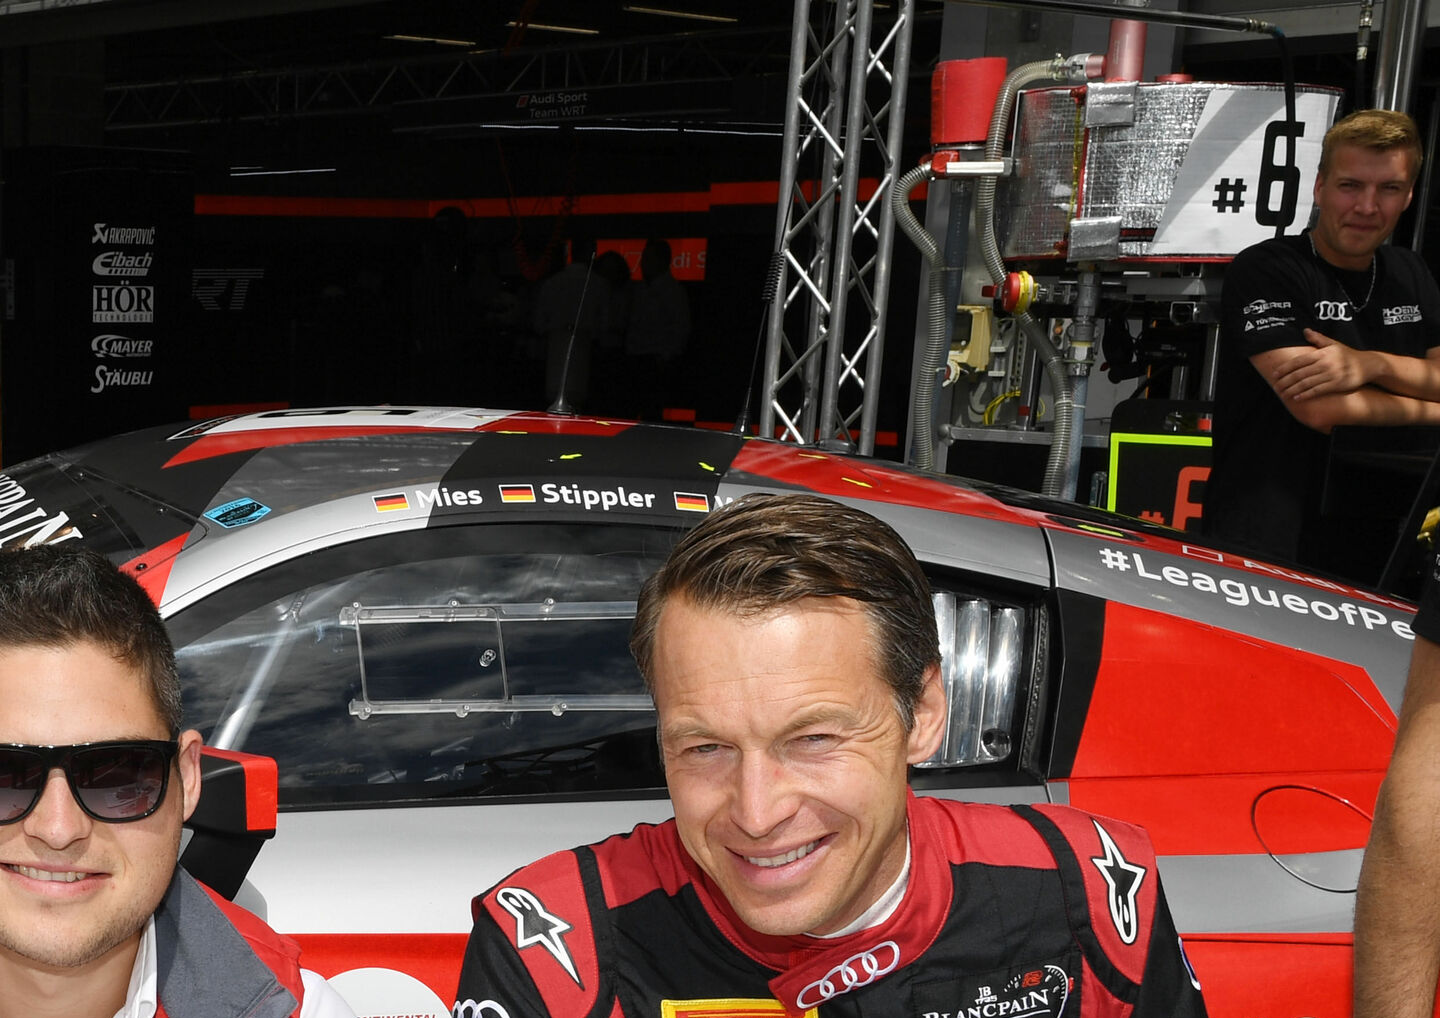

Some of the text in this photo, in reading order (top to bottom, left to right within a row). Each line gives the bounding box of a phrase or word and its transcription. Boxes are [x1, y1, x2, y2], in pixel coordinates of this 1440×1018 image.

[529, 91, 588, 105] Audi Sport
[92, 251, 153, 276] Eibach
[94, 280, 153, 313] HÖR
[109, 340, 153, 354] MAYER
[91, 364, 153, 393] STÄUBLI
[415, 483, 656, 510] Mies Stippler
[1098, 547, 1417, 642] #LeagueofPe
